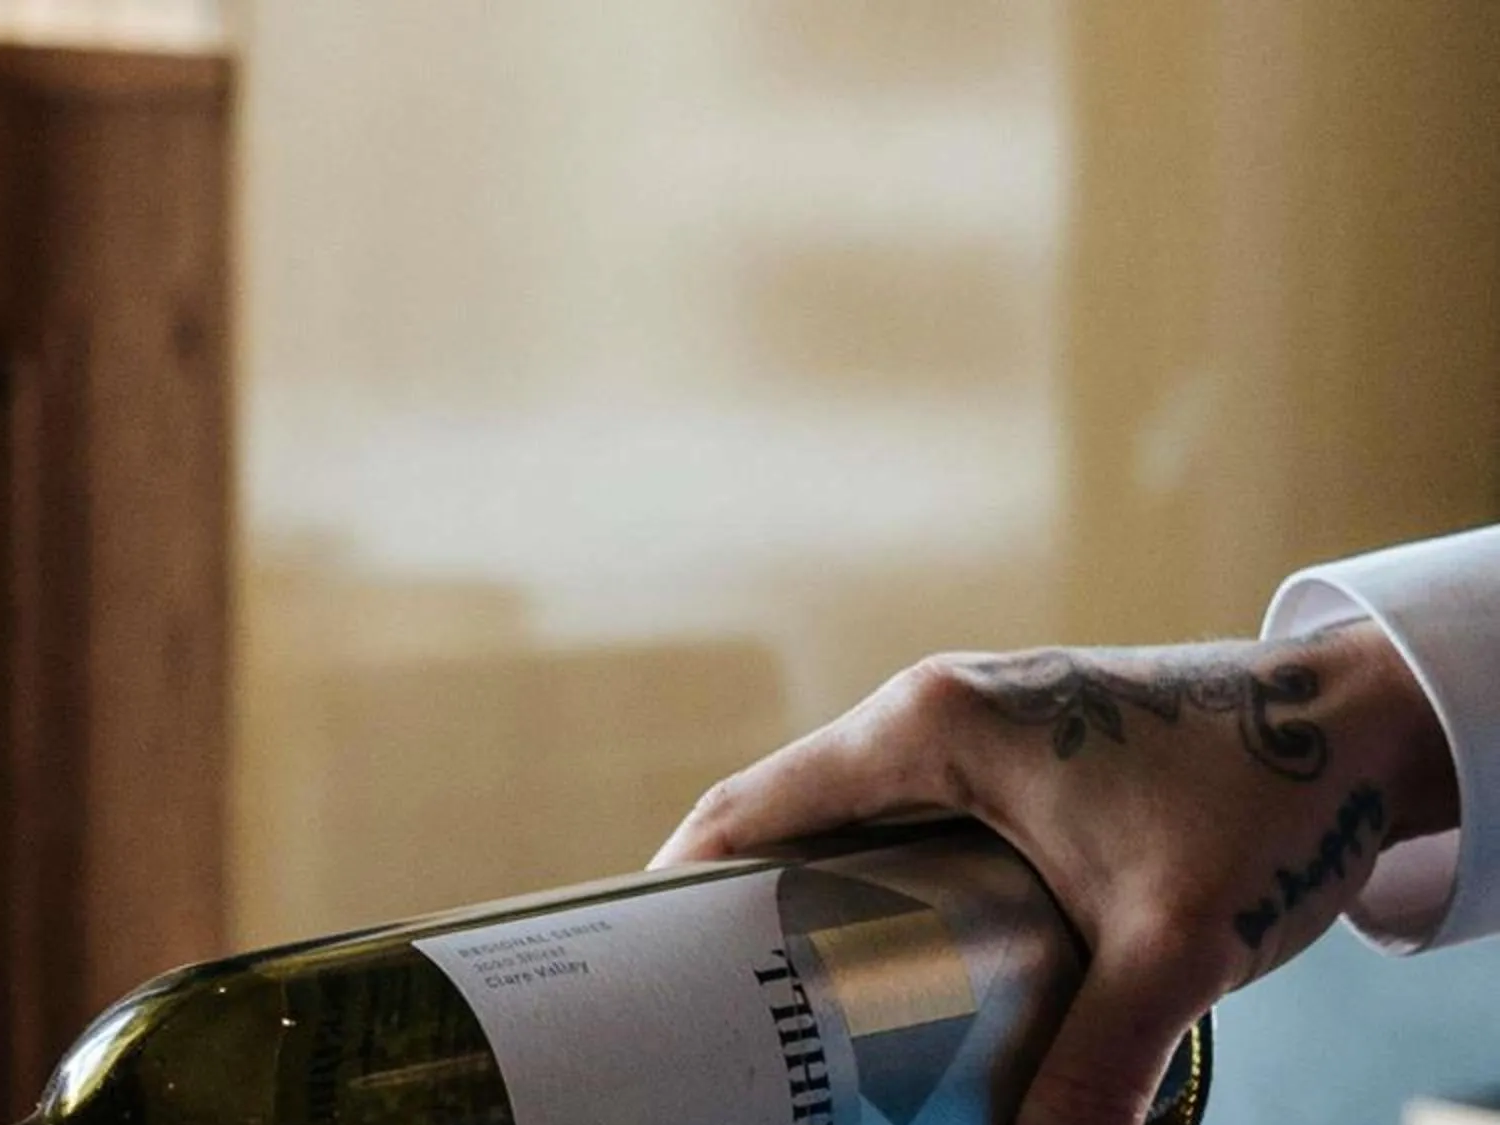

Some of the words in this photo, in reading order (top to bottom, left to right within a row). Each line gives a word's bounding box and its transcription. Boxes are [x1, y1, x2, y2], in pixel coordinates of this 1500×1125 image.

[457, 933, 550, 958] REGIONAL
[484, 971, 534, 989] Clare
[533, 960, 589, 979] Valley
